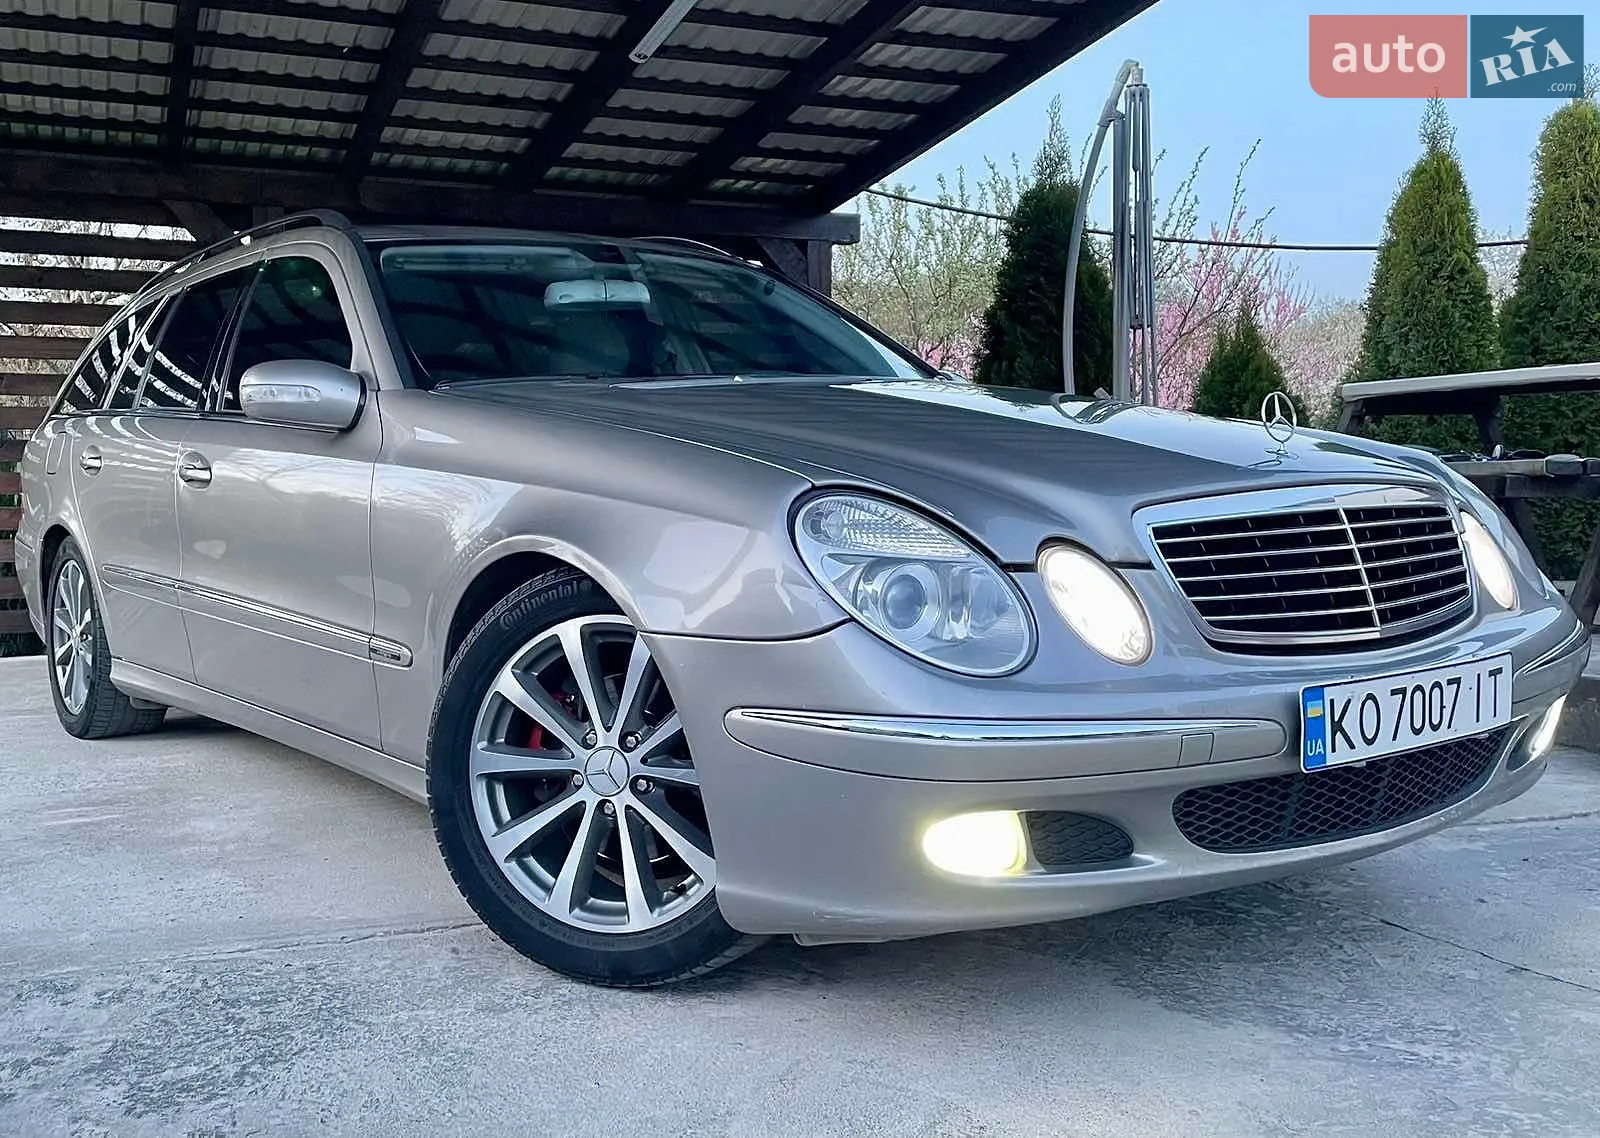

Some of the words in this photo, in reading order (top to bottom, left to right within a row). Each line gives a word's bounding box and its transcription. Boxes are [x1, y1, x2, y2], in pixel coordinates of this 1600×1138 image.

[1329, 692, 1382, 753] KO
[1390, 676, 1462, 741] 7007
[1475, 667, 1504, 723] IT
[1307, 739, 1325, 756] UA
